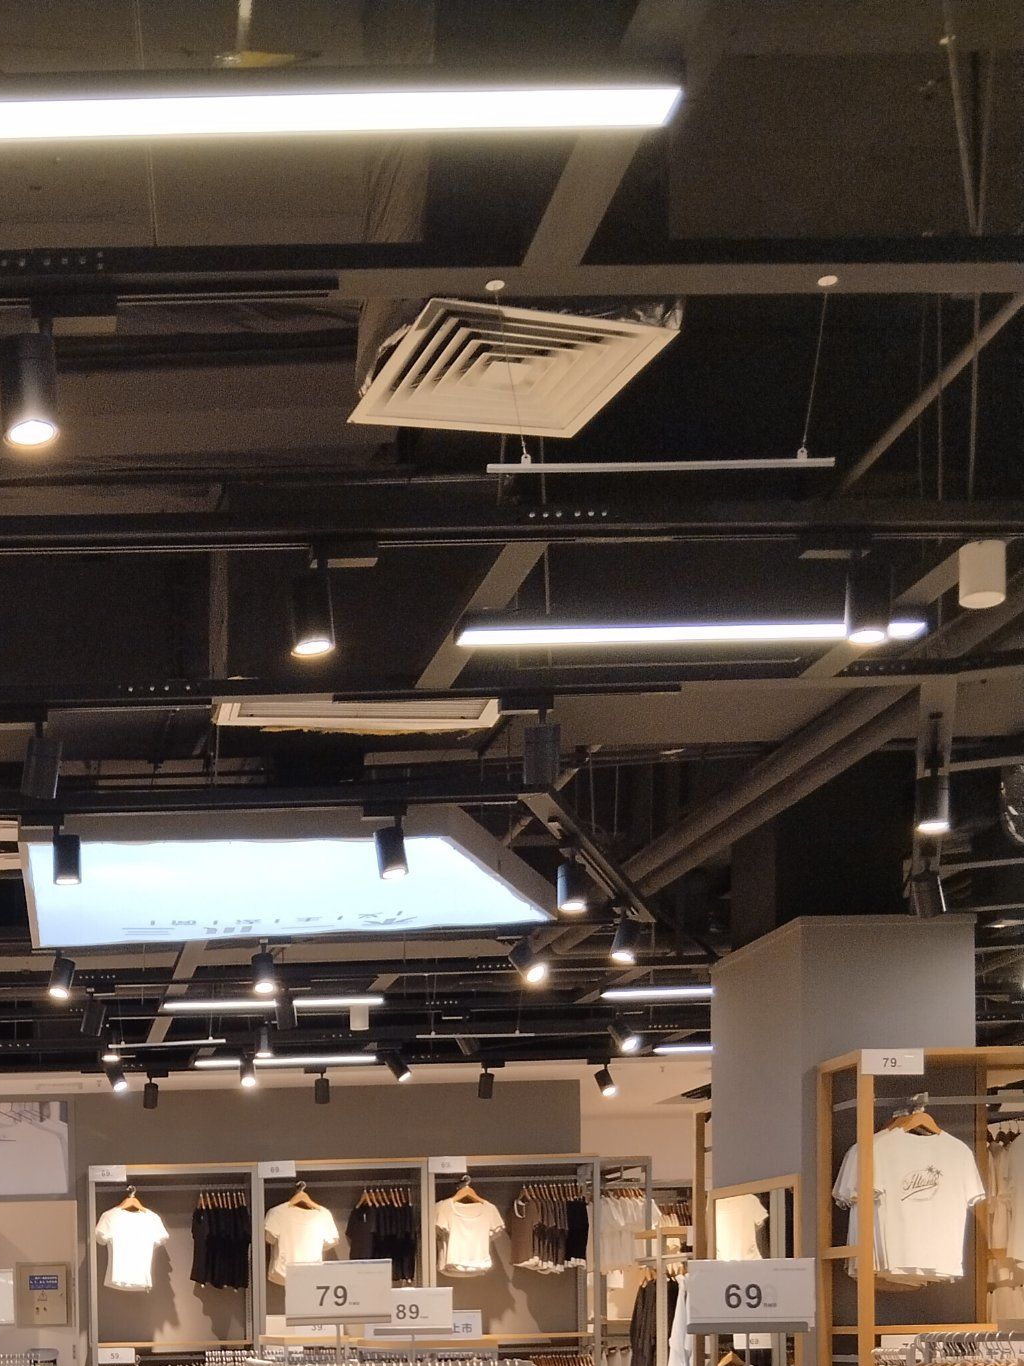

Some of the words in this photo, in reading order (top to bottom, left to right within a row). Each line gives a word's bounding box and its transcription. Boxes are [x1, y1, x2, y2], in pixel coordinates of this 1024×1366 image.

[882, 1057, 897, 1068] 79
[315, 1285, 348, 1307] 79
[724, 1283, 763, 1309] 69
[395, 1304, 420, 1320] 89
